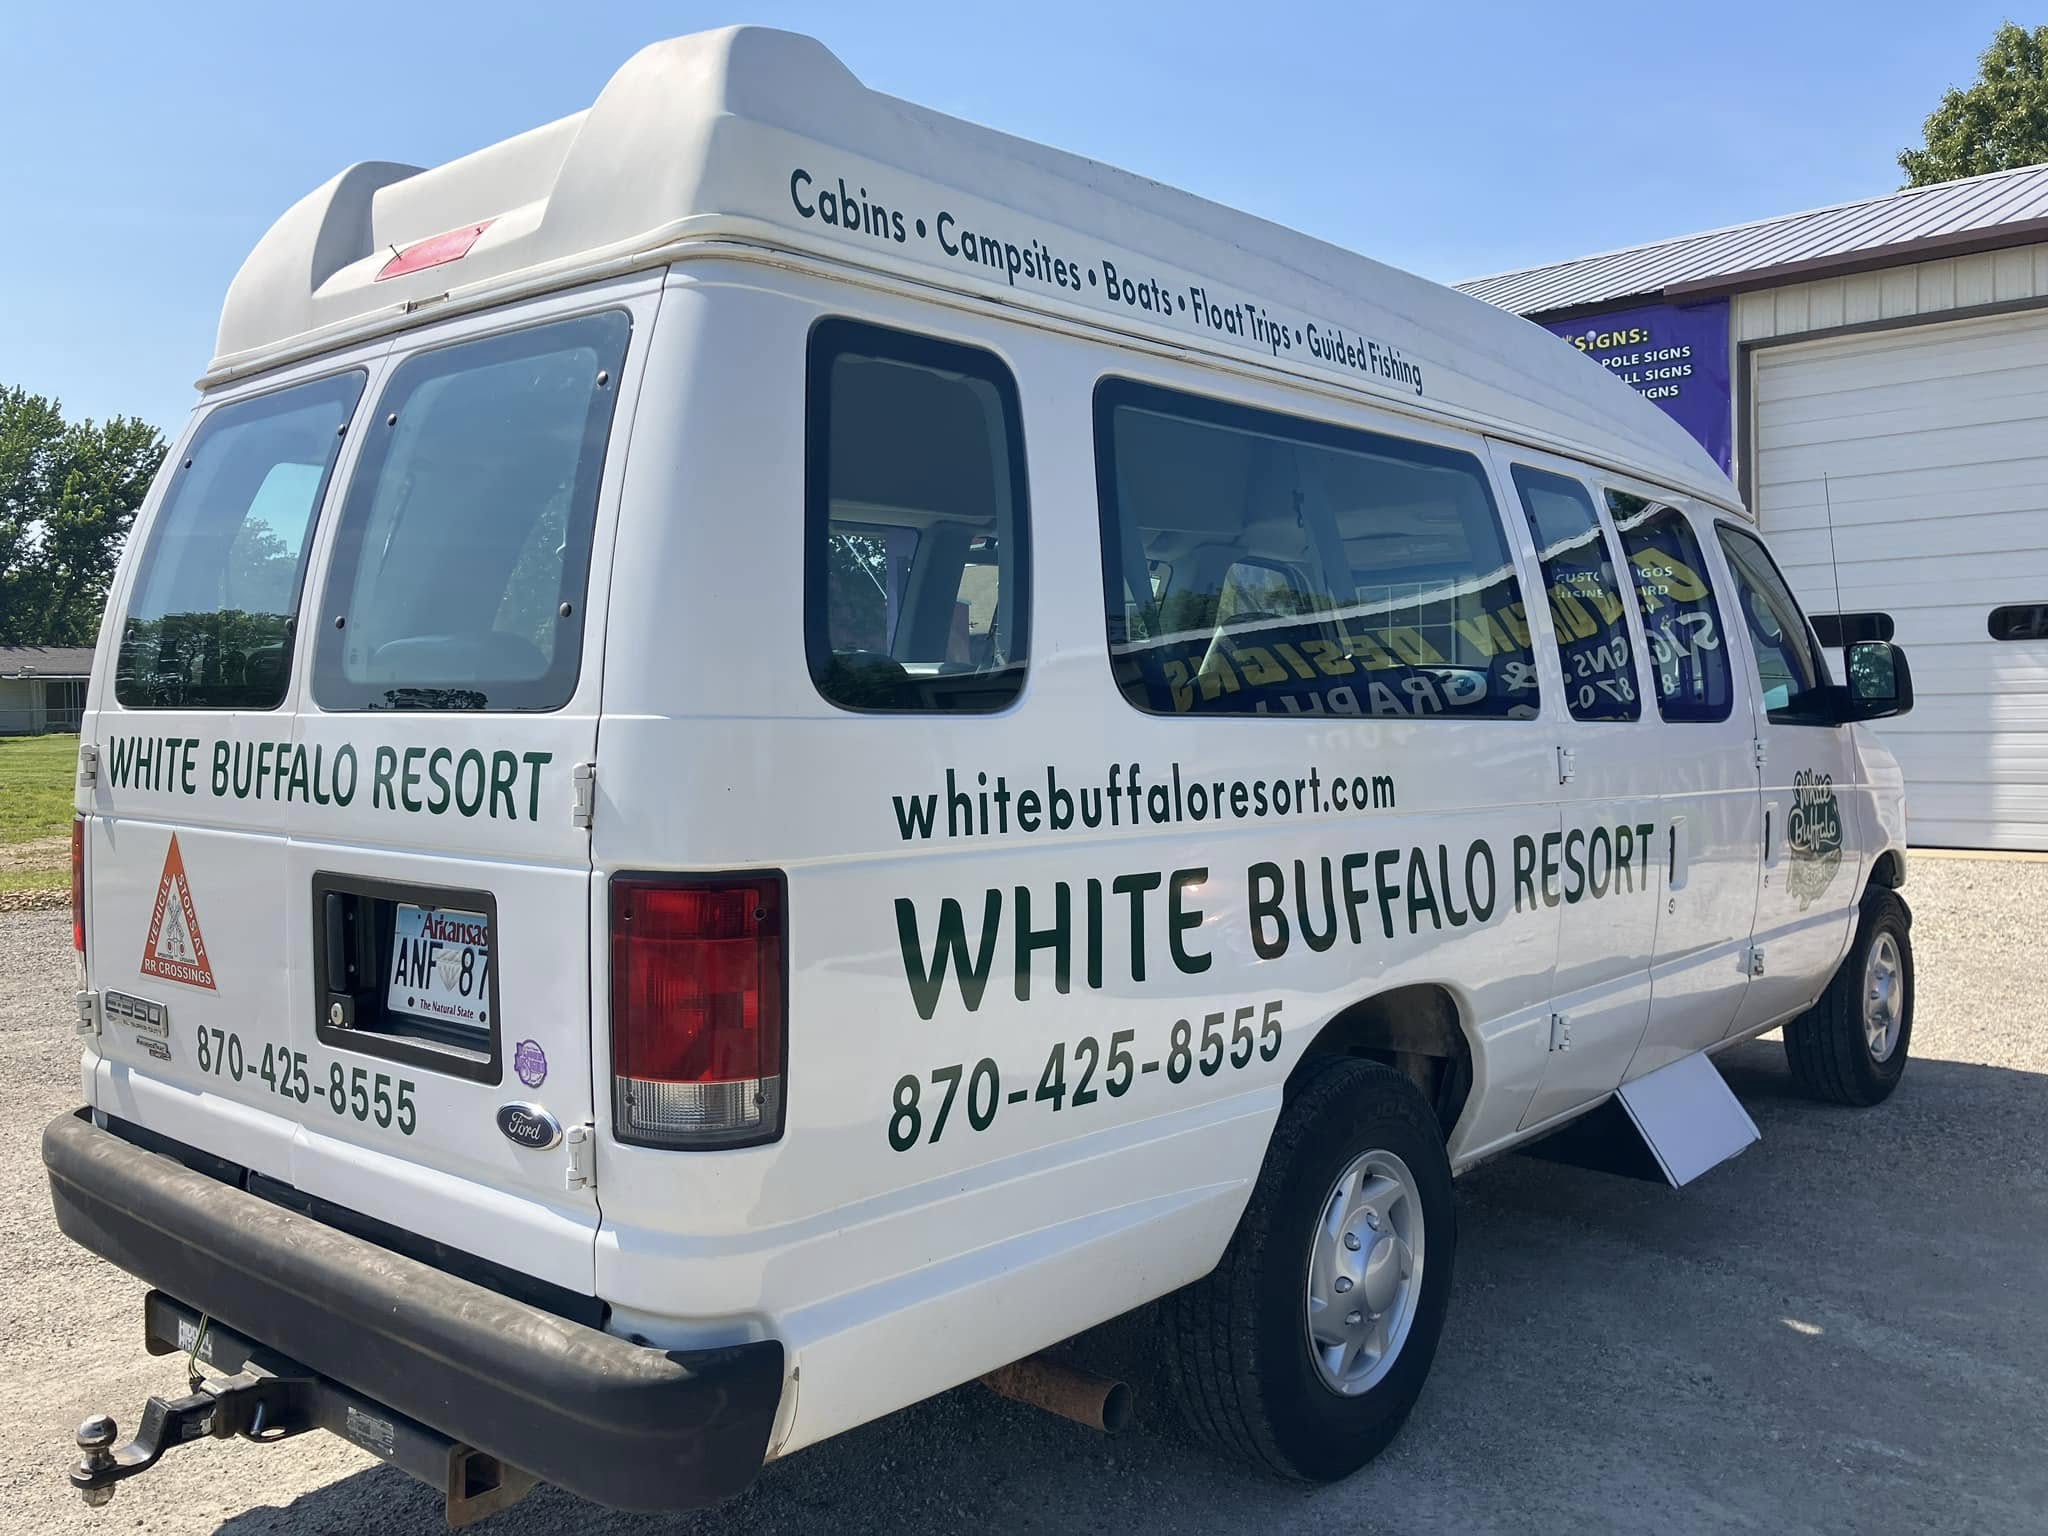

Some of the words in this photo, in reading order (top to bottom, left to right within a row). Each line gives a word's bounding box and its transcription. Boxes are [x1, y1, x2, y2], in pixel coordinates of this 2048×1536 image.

[790, 169, 906, 245] Cabins
[936, 211, 1082, 292] Campsites
[1101, 260, 1173, 316] Boats
[1189, 287, 1245, 337] Float
[1244, 304, 1291, 356] Trips
[1307, 323, 1367, 373] Guided
[1369, 338, 1424, 396] Fishing
[1602, 353, 1640, 368] POLE
[1644, 345, 1691, 363] SIGNS
[1616, 372, 1641, 384] LL
[1645, 364, 1693, 381] SIGNS
[1636, 385, 1679, 399] IGNS
[110, 735, 200, 794] WHITE
[211, 741, 358, 807] BUFFALO
[372, 746, 553, 822] RESORT
[892, 763, 1397, 840] whitebuffaloresort.com
[1794, 768, 1833, 807] White
[1789, 803, 1838, 850] Buffalo
[149, 873, 170, 945] VEHICLE
[177, 873, 198, 931] STOPS
[193, 937, 206, 956] AT
[421, 912, 488, 947] Arkansas
[894, 867, 1214, 1020] WHITE
[1248, 839, 1496, 960] BUFFALO
[1513, 823, 1654, 915] RESORT
[144, 958, 157, 972] RR
[158, 961, 212, 984] CROSSINGS
[394, 937, 443, 990] ANF
[420, 999, 431, 1010] The
[431, 1001, 456, 1016] Natural
[456, 1007, 474, 1019] State
[197, 1024, 417, 1136] 870-425-8555
[888, 1000, 1284, 1152] 870-425-8555
[508, 1111, 541, 1140] Ford
